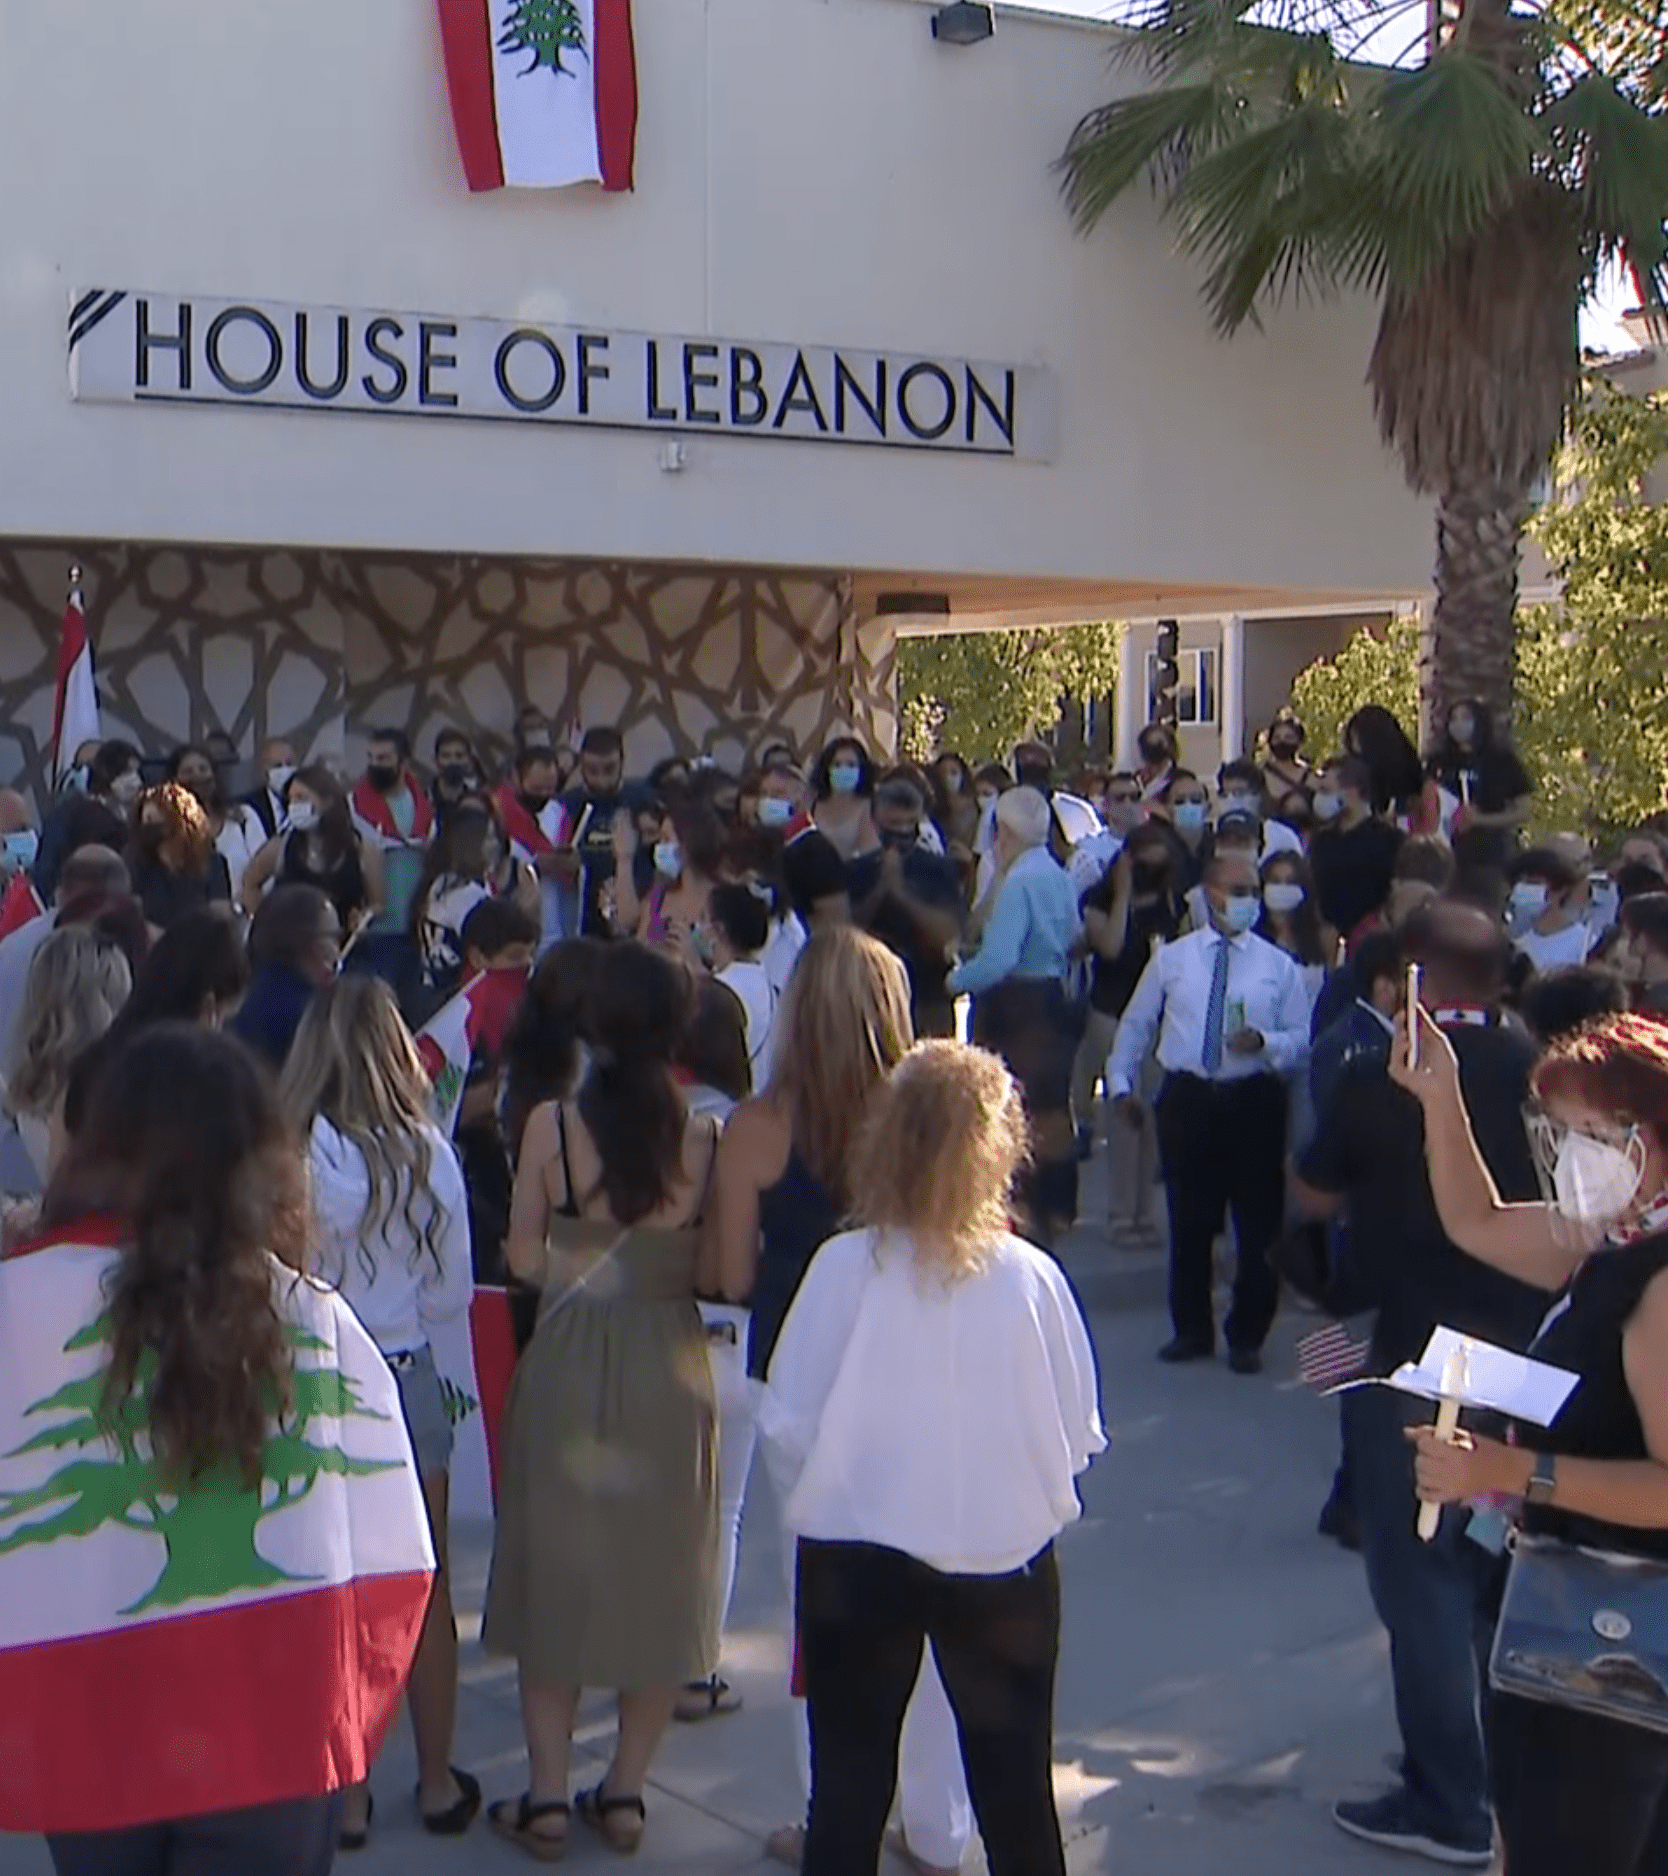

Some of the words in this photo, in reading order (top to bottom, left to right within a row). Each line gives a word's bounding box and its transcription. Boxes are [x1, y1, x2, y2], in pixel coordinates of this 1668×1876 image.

[135, 299, 459, 407] HOUSE
[494, 328, 610, 415] OF
[647, 340, 1014, 447] LEBANON
